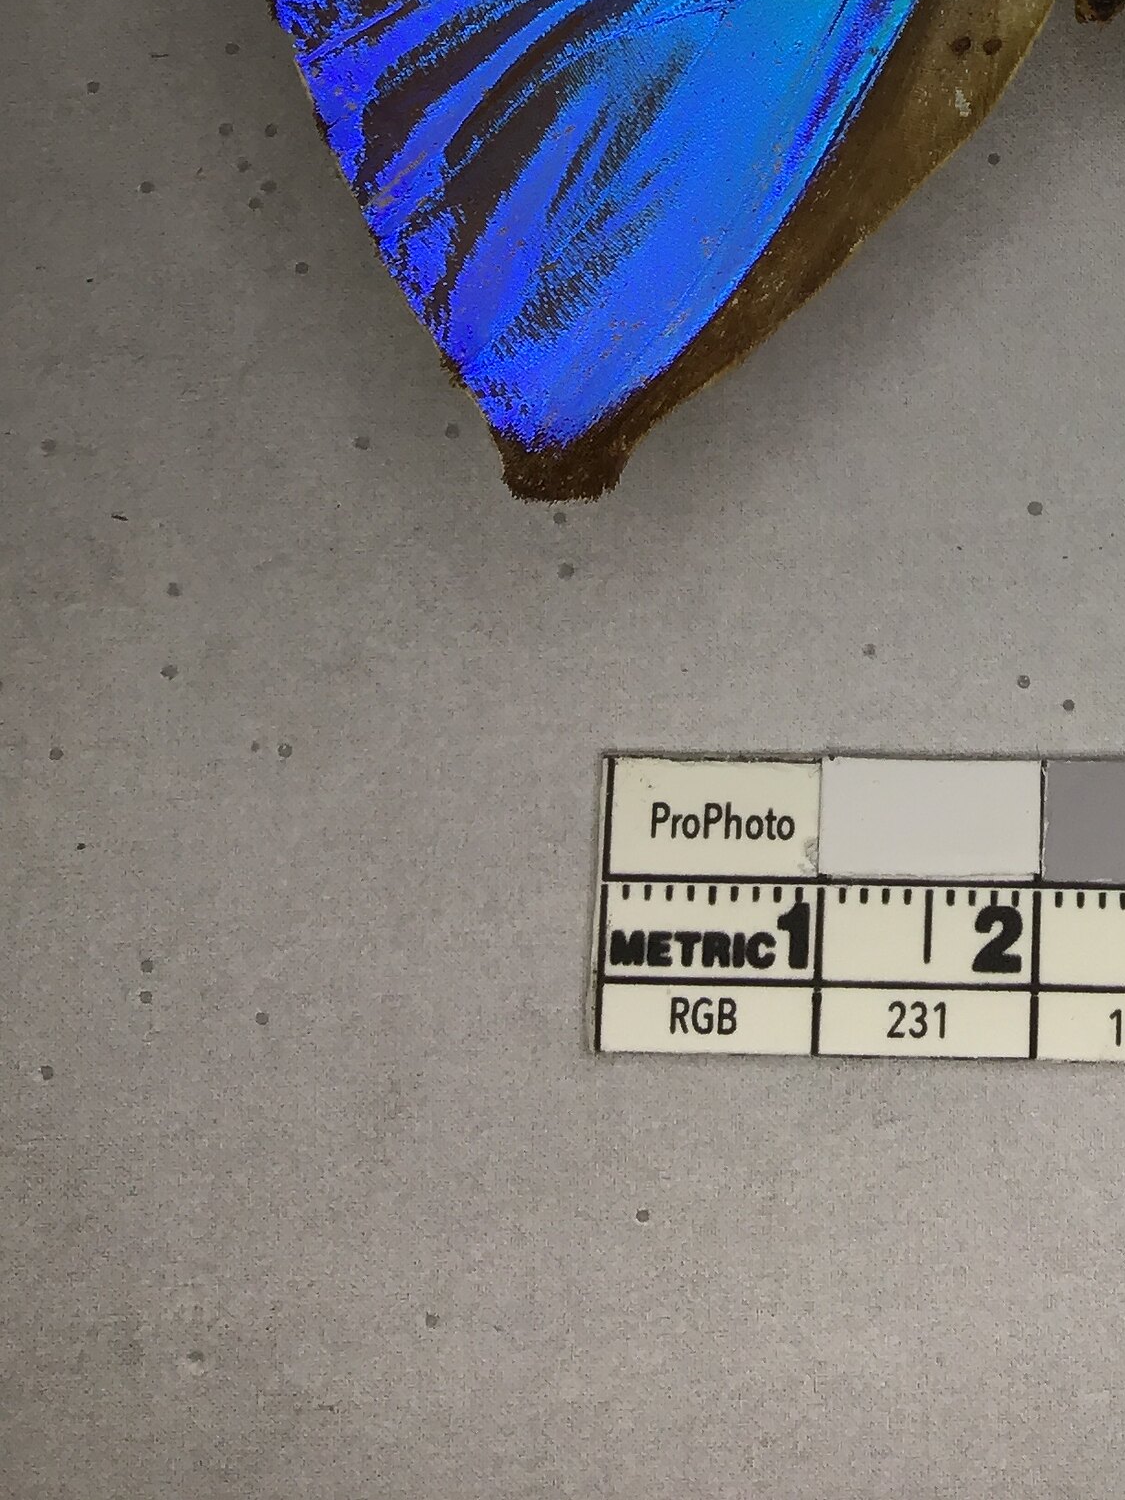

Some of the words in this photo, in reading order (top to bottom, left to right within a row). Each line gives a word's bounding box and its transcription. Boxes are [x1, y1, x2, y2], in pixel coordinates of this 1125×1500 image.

[651, 802, 795, 841] ProPhoto
[609, 930, 776, 969] METRIC
[777, 902, 811, 969] 1
[972, 904, 1023, 973] 2
[670, 997, 737, 1035] RGB
[887, 1001, 947, 1039] 231
